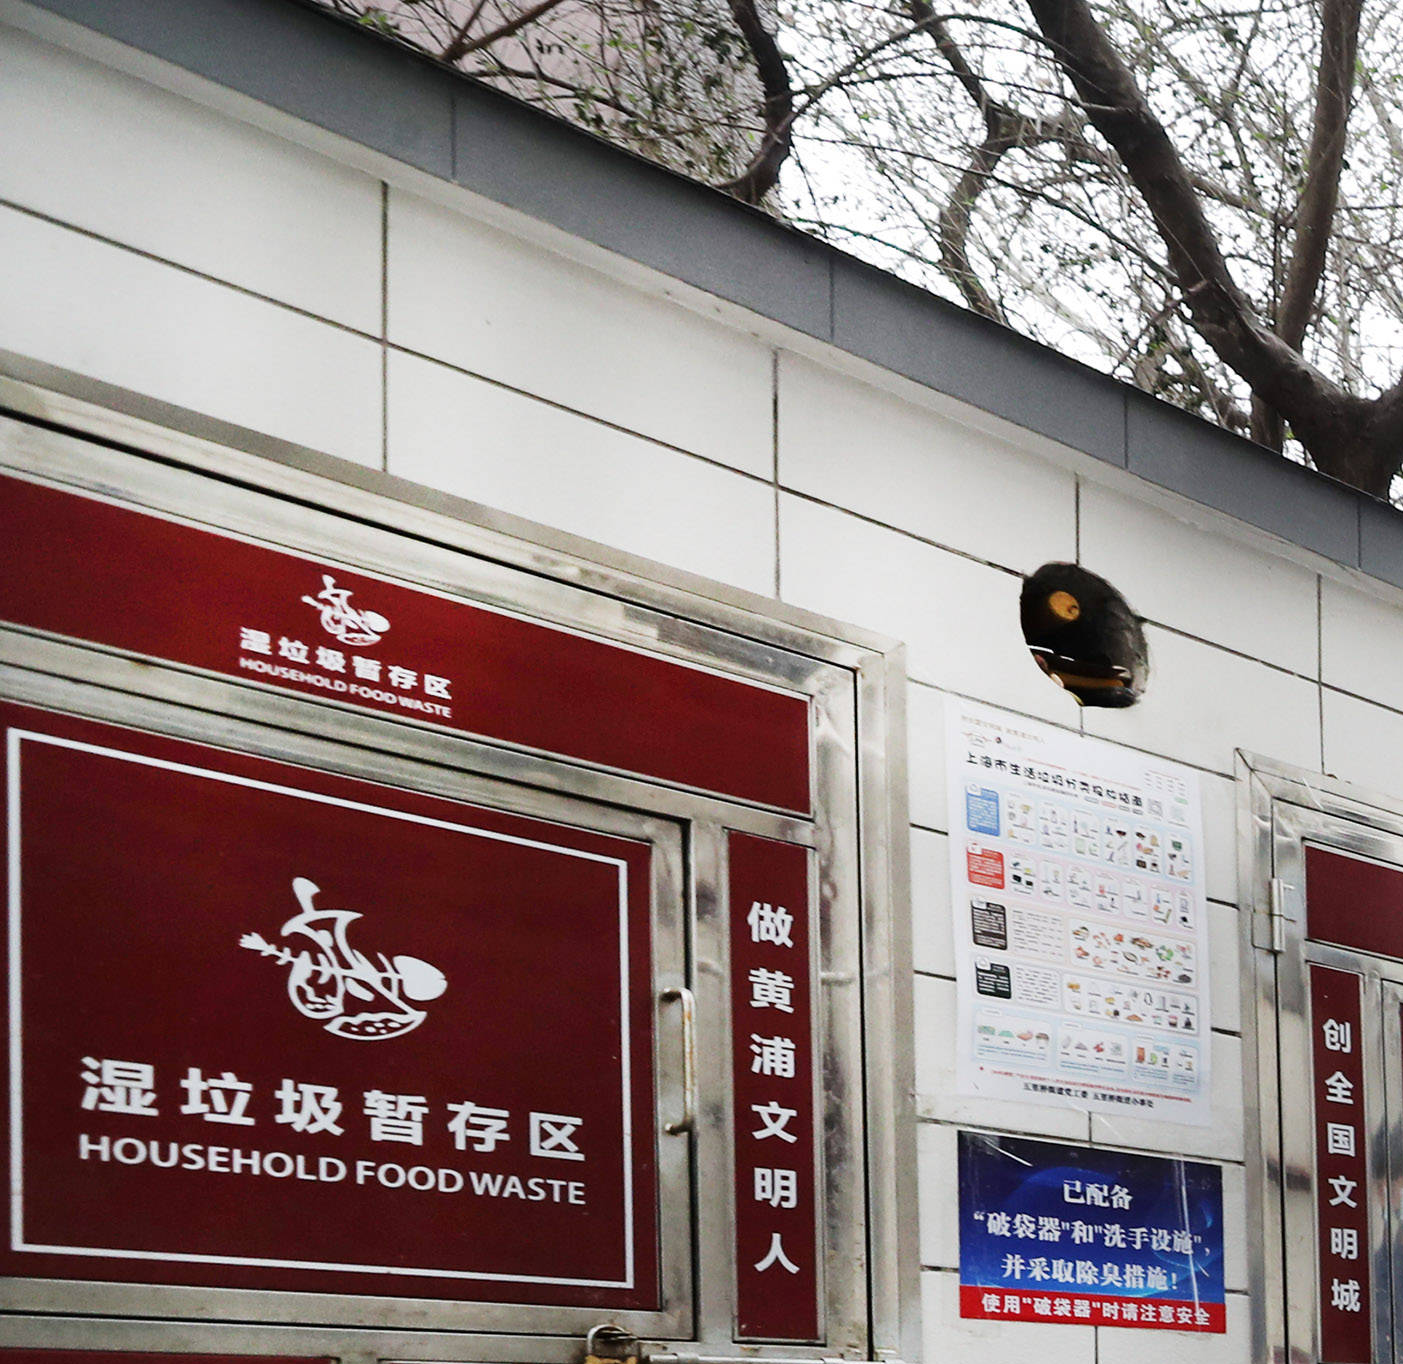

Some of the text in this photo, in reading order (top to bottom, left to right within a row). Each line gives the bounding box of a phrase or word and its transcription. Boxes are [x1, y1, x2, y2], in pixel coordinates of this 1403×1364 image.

[239, 657, 453, 719] HOUSEHOLD FOOD WASTE
[240, 626, 453, 700] 湿垃圾暂存区
[80, 1056, 586, 1162] 湿垃圾暂存区
[747, 901, 800, 1275] 做黄浦文明人
[78, 1133, 586, 1205] HOUSEHOLD FOOD WASTE
[1063, 1179, 1133, 1210] 已配备
[1322, 1017, 1361, 1314] 创全国文明城
